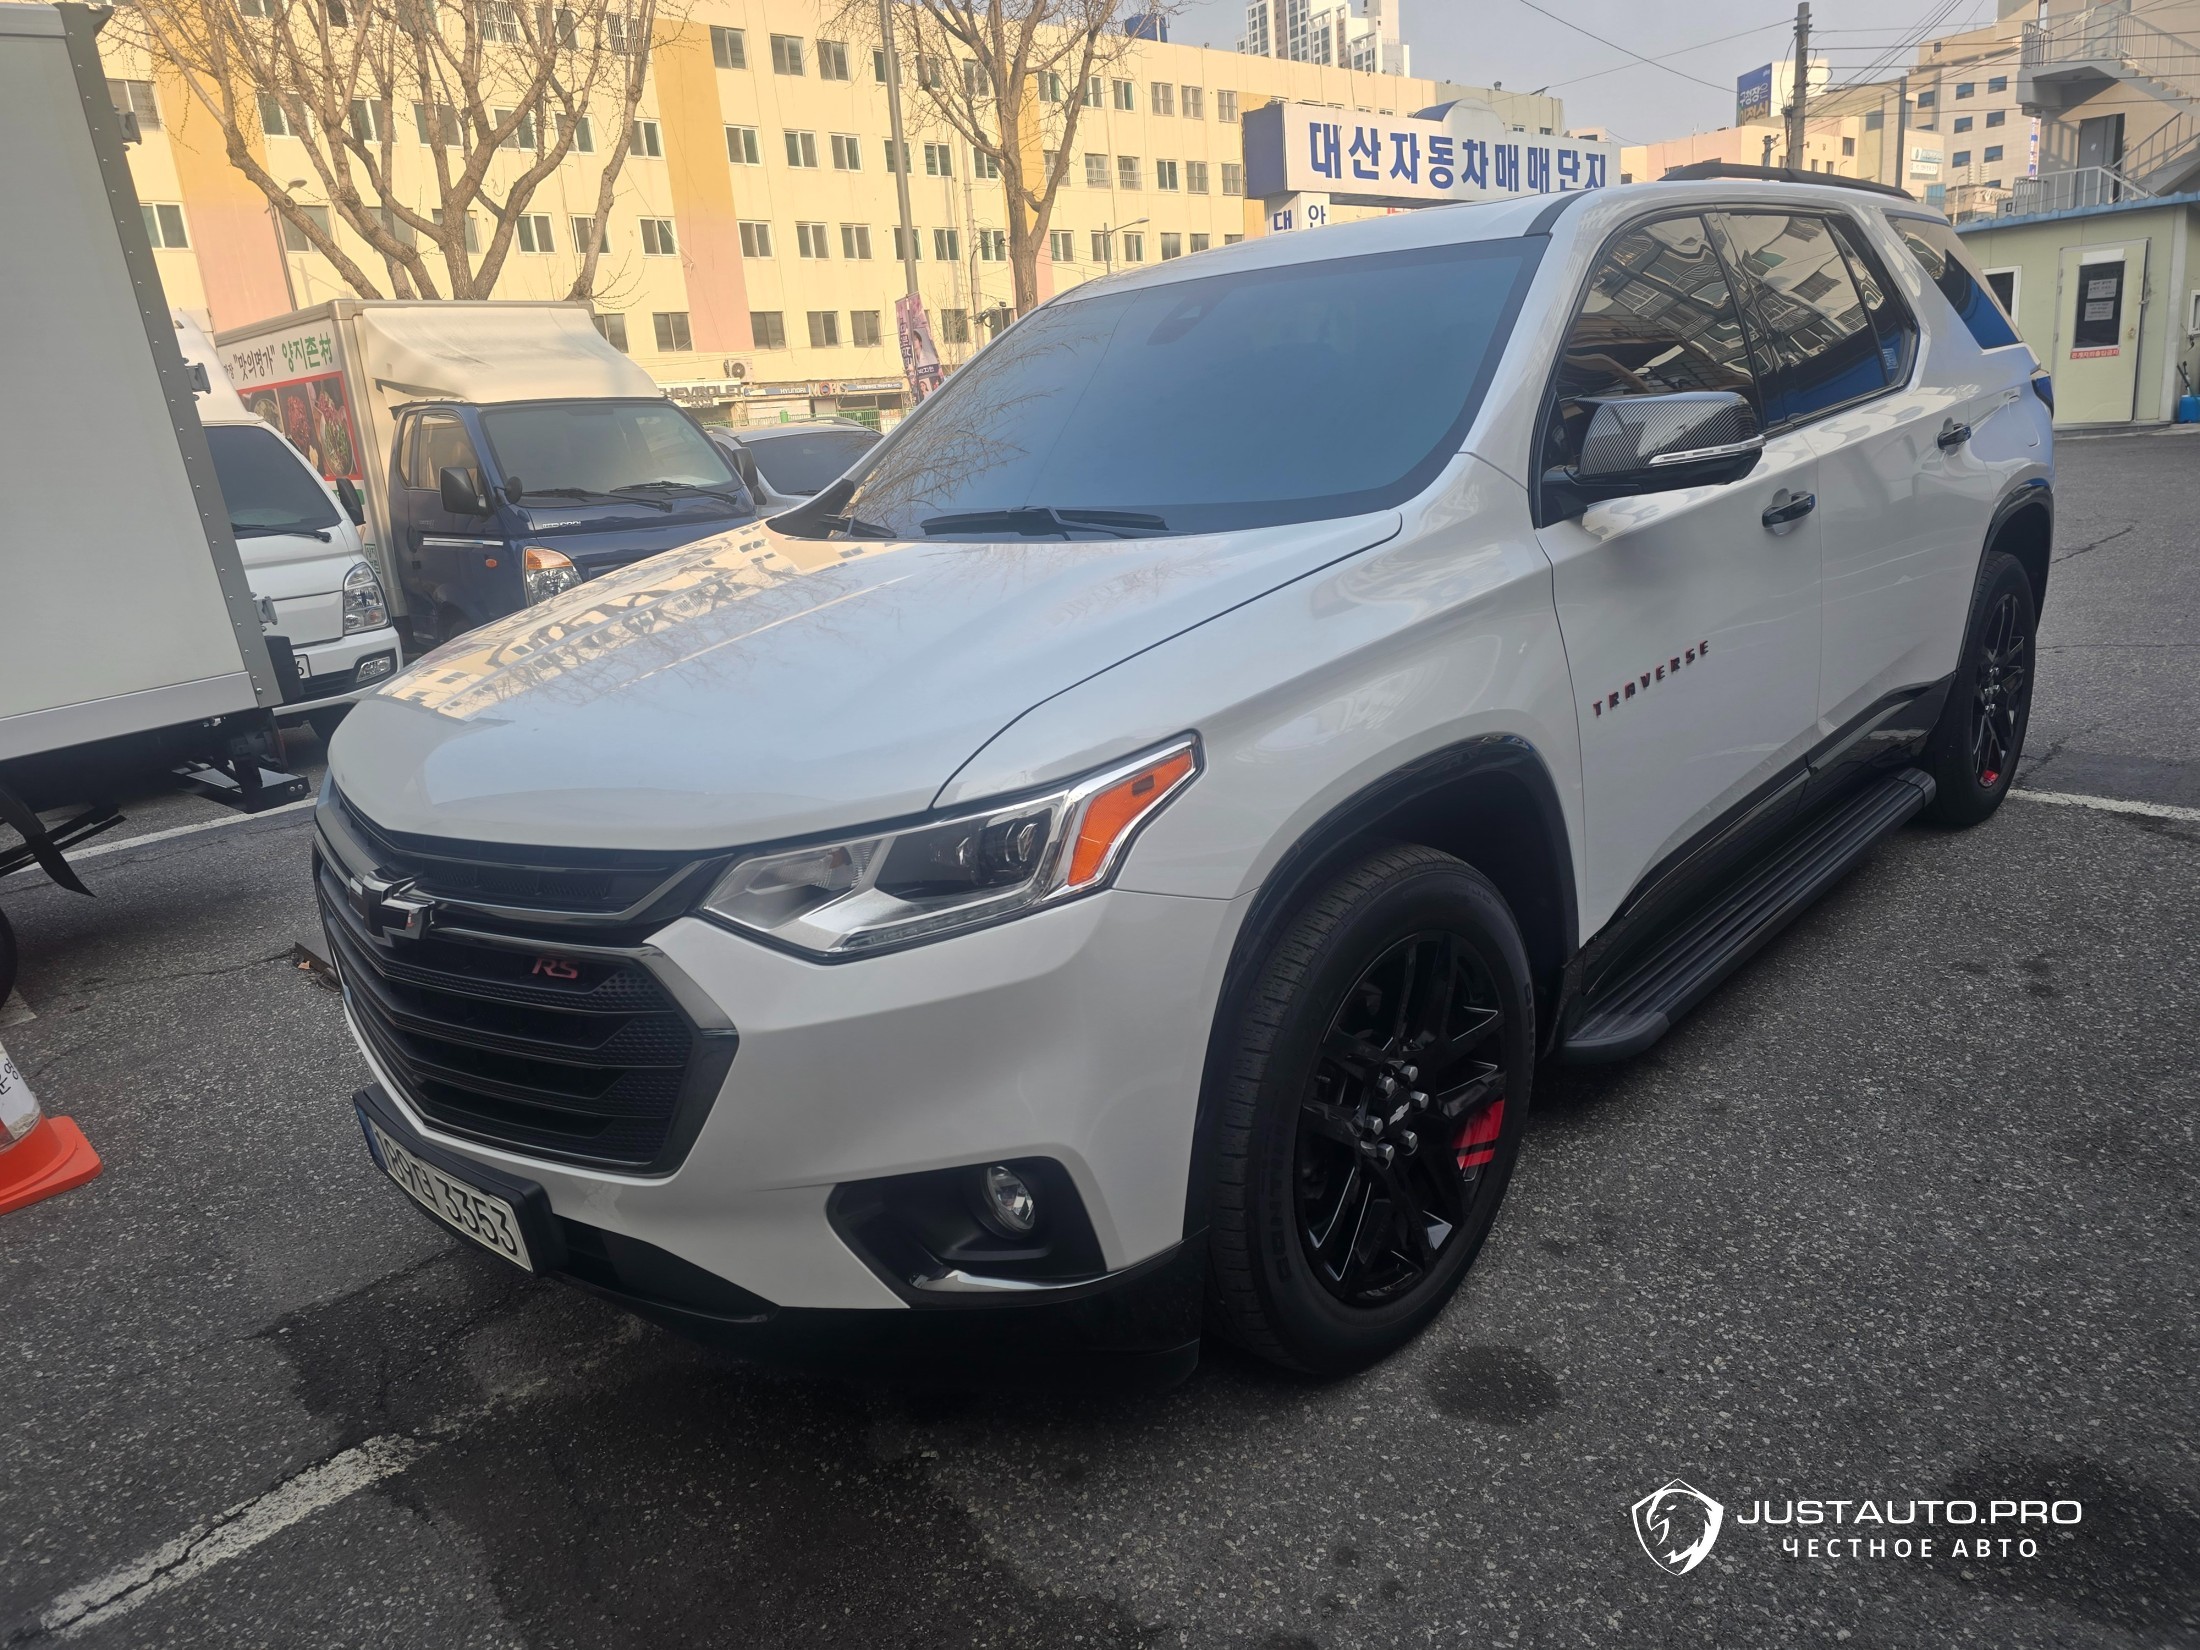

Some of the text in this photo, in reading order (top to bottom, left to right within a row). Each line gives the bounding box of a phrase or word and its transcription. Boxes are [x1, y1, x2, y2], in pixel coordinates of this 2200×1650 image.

[1309, 121, 1606, 193] 대산자동차매매단지
[1273, 210, 1293, 231] 대
[281, 331, 333, 373] 양지촌村
[1593, 640, 1709, 717] TRAVERSE
[532, 958, 578, 979] RS
[434, 1175, 519, 1257] 3353
